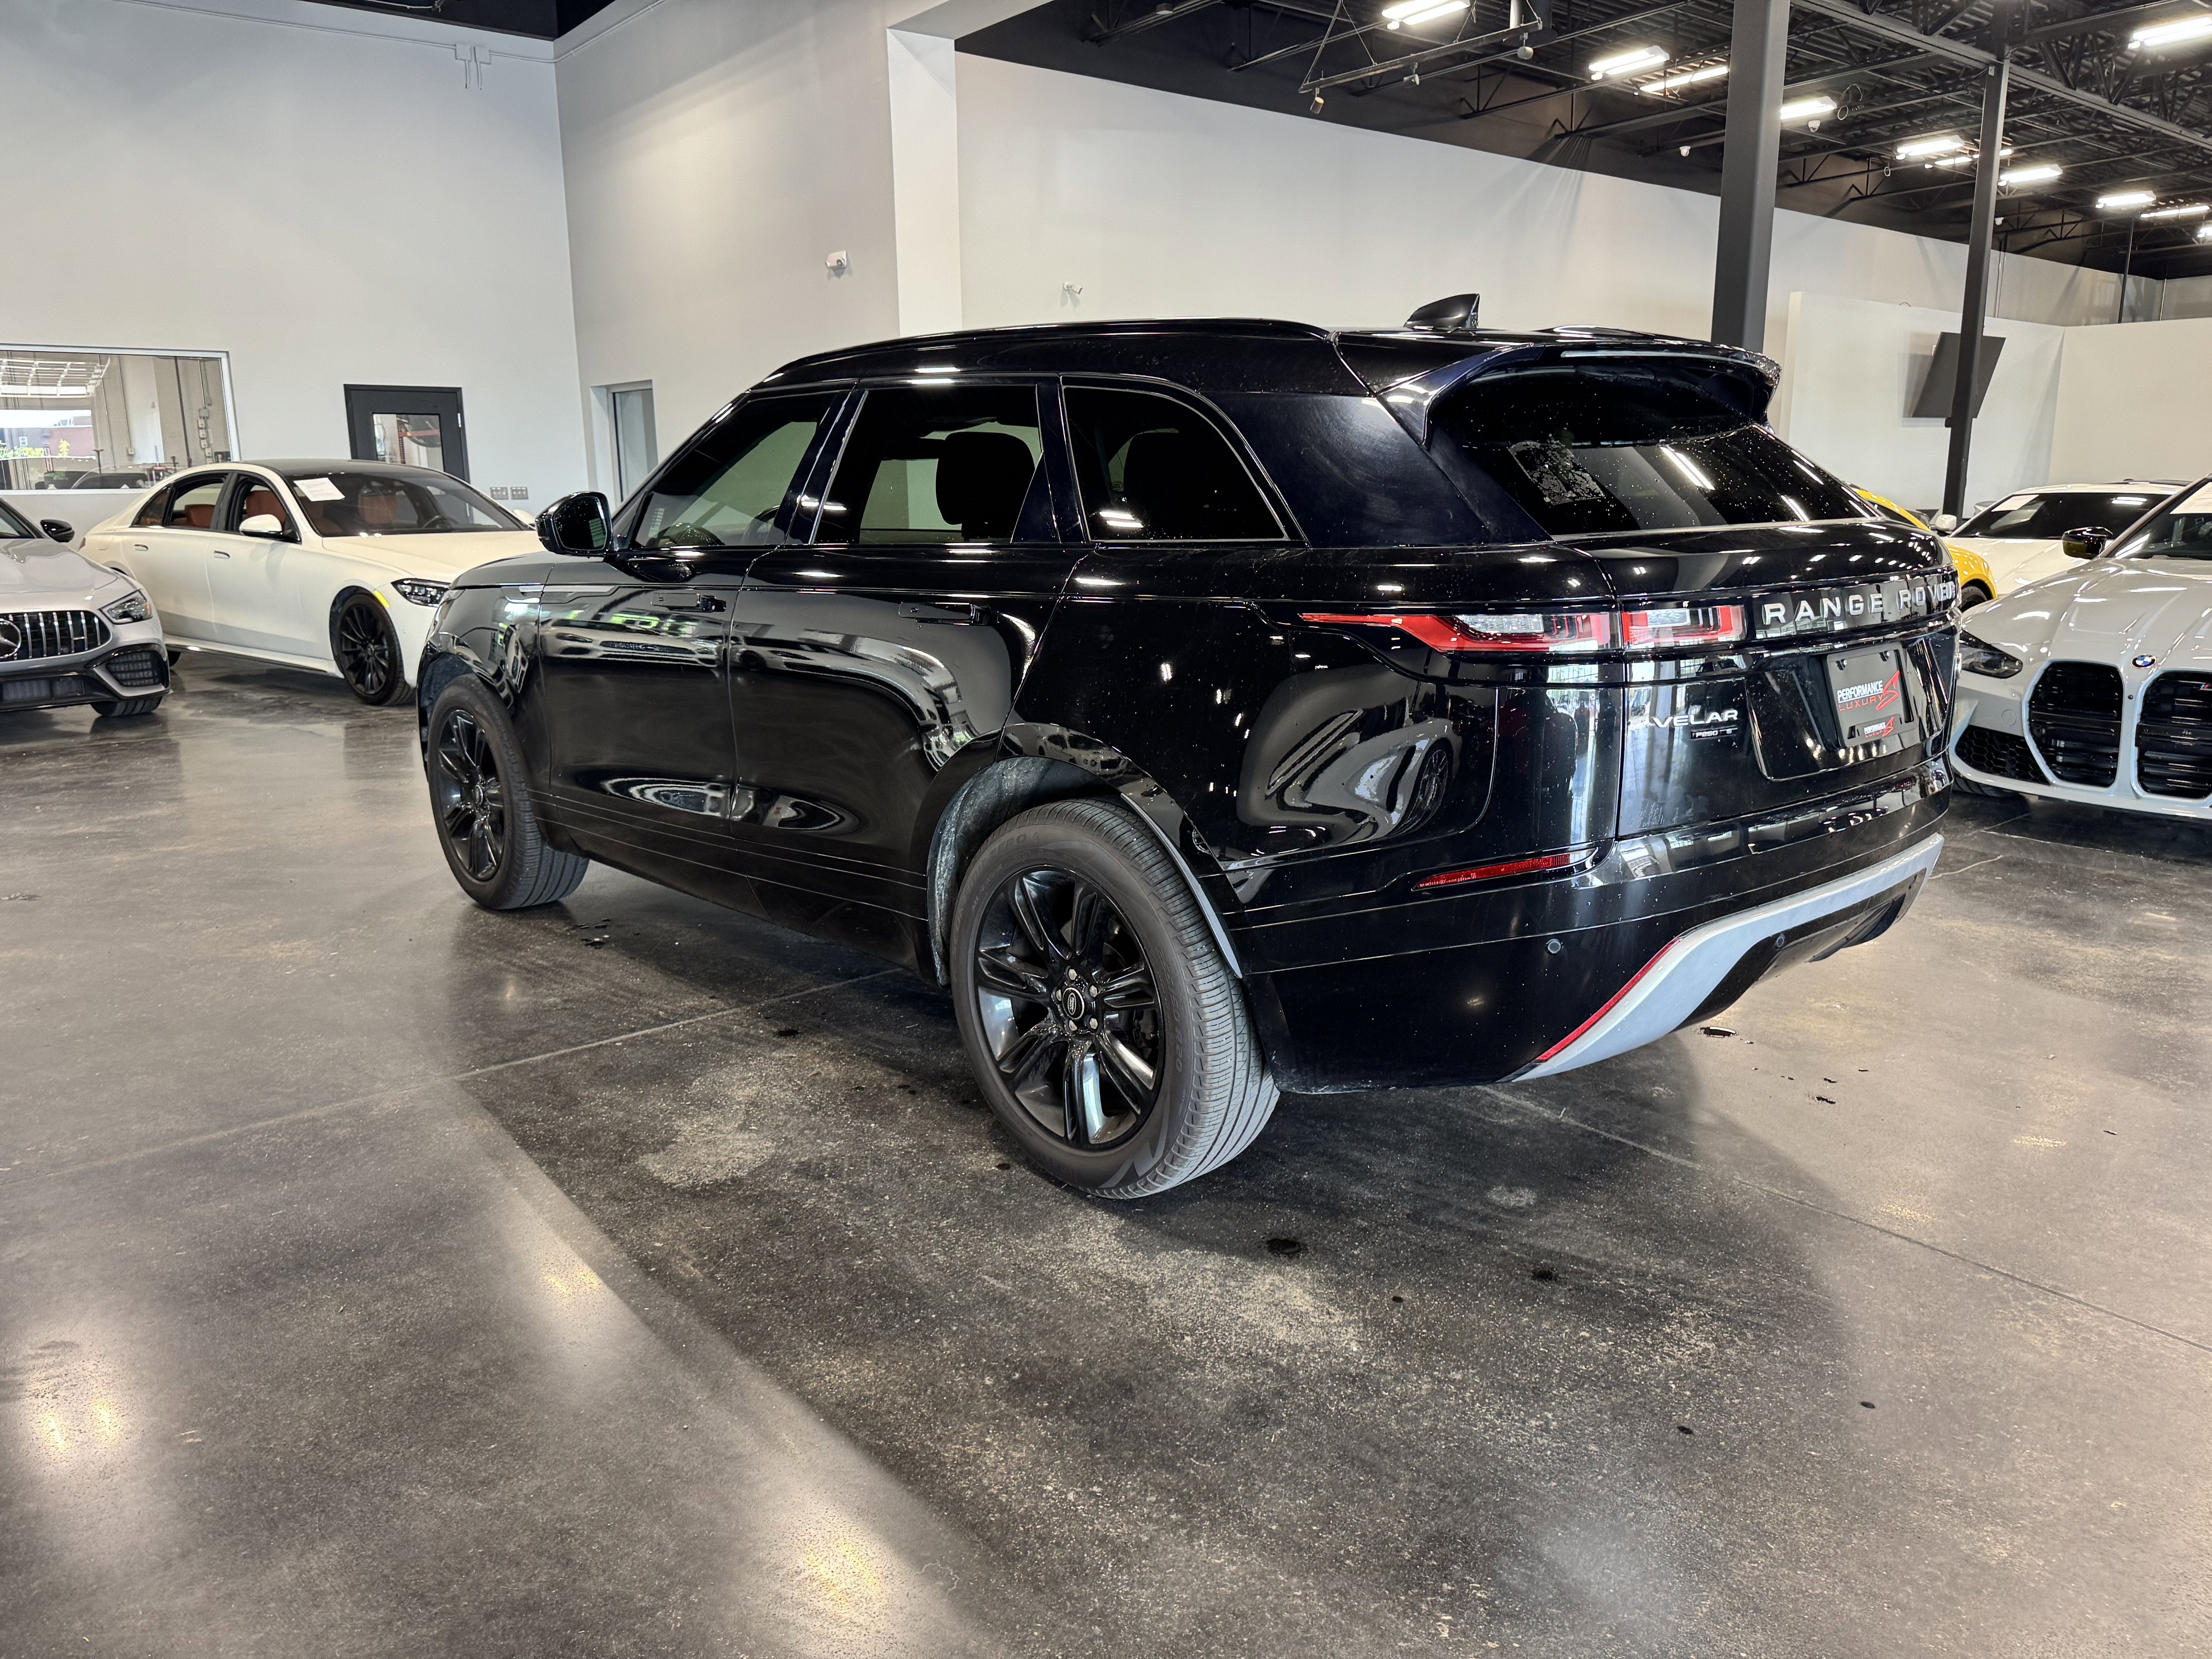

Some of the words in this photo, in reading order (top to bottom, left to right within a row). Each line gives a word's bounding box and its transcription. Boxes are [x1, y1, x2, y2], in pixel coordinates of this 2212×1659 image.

[1762, 593, 1883, 625] RANGE
[1837, 680, 1883, 702] PERFORMANCE
[1839, 694, 1884, 711] LUXURY
[1653, 709, 1738, 728] VELAR
